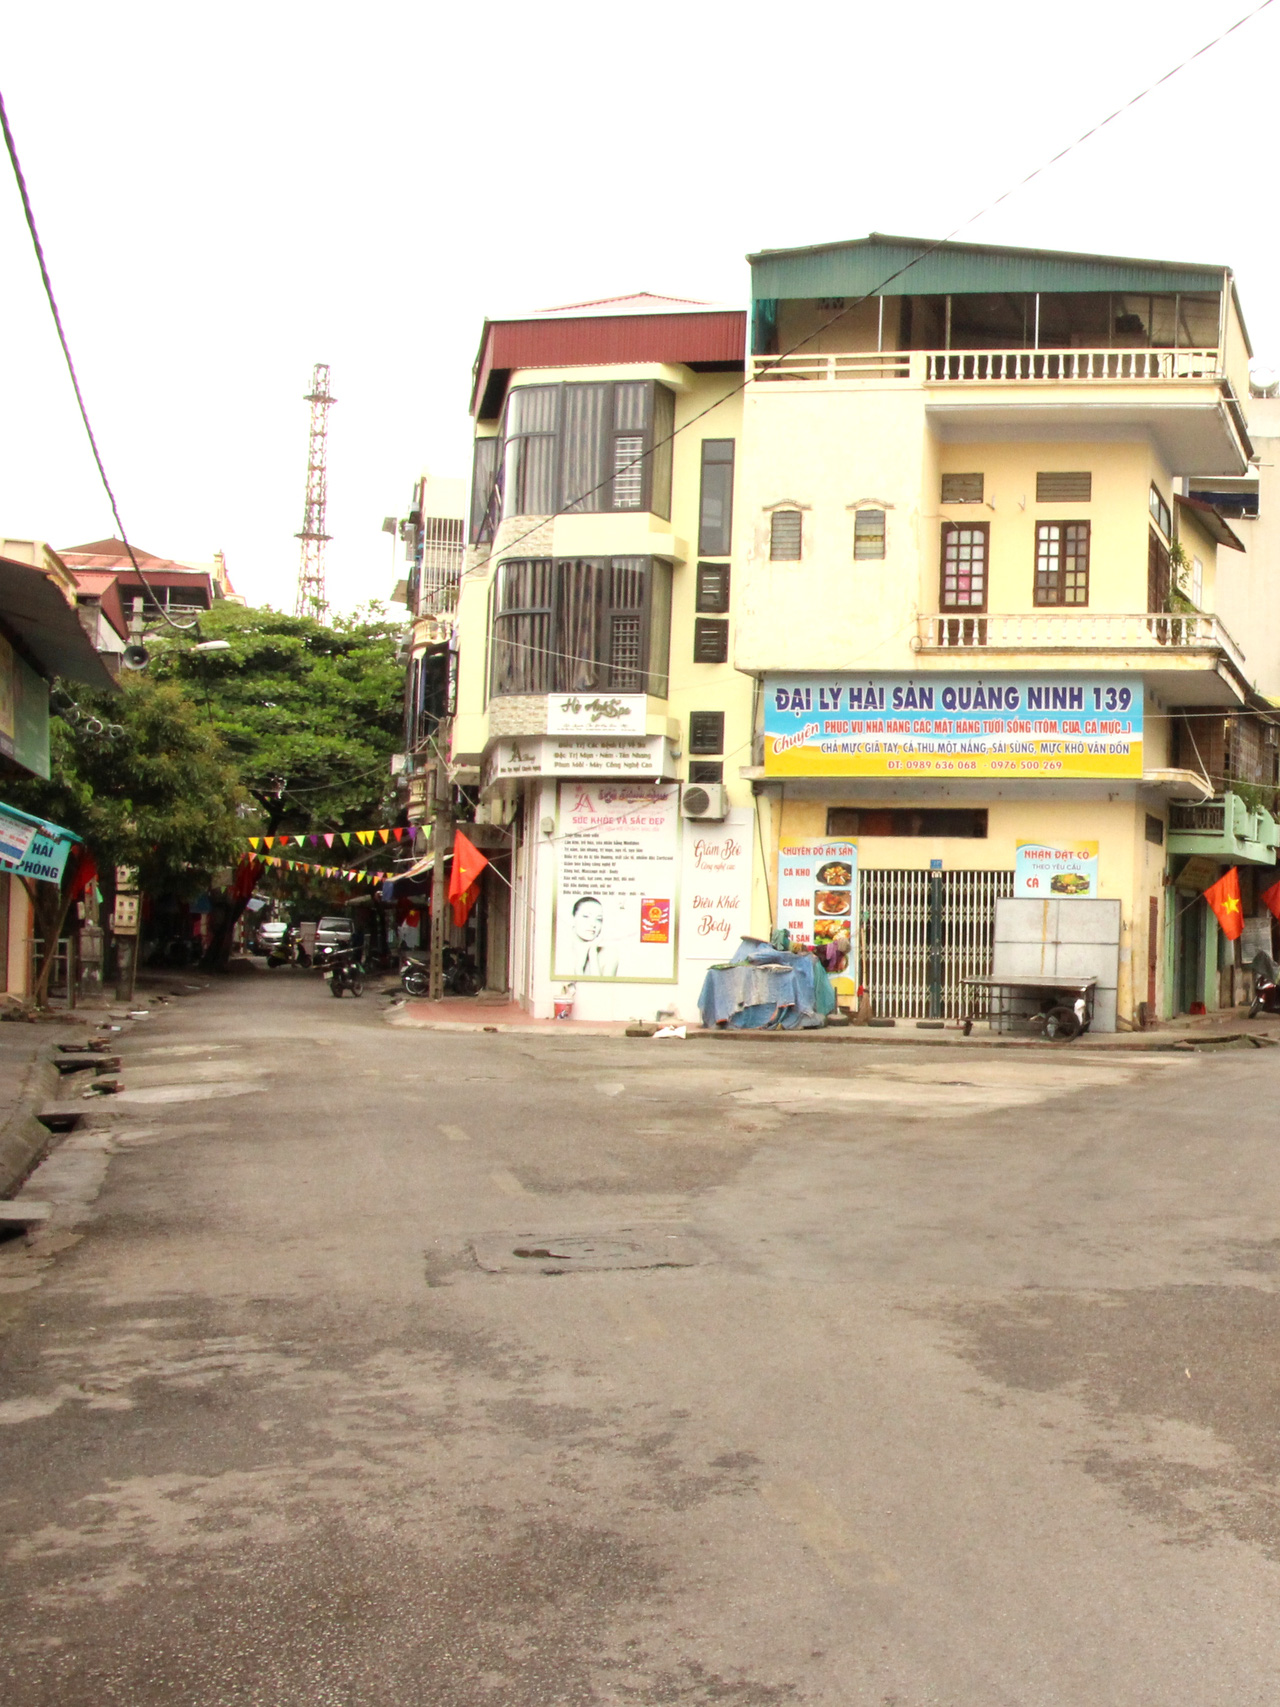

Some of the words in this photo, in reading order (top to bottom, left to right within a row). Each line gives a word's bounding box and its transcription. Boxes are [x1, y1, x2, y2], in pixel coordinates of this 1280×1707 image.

[775, 687, 811, 717] ĐẠI
[819, 682, 842, 710] LÝ
[849, 681, 885, 710] HẢI
[892, 681, 934, 710] SẢN
[942, 681, 1020, 711] QUẢNG
[1027, 687, 1083, 710] NINH
[1093, 687, 1132, 711] 139
[824, 720, 848, 735] PHỤC
[851, 720, 863, 735] VỤ
[866, 718, 884, 733] NHÀ
[886, 718, 911, 733] HÀNG
[914, 717, 932, 733] CÁC
[956, 718, 980, 734] HÀNG
[983, 718, 1004, 734] TƯƠI
[1007, 716, 1031, 734] SỐNG
[773, 722, 820, 755] Chuyên
[820, 741, 838, 753] CHẢ
[841, 742, 862, 755] MỰC
[903, 740, 914, 753] CÁ
[917, 742, 935, 753] THU
[937, 741, 957, 755] MỘT
[1040, 742, 1062, 756] MỰC
[1065, 741, 1084, 754] KHÔ
[1088, 741, 1106, 754] VÂN
[888, 760, 903, 769] ĐT:
[906, 761, 931, 769] 0989
[935, 761, 954, 769] 636
[957, 761, 977, 769] 068
[990, 761, 1016, 769] 0976
[1020, 761, 1039, 769] 500
[1043, 761, 1062, 769] 269
[697, 914, 731, 941] Body
[788, 921, 804, 929] NEM
